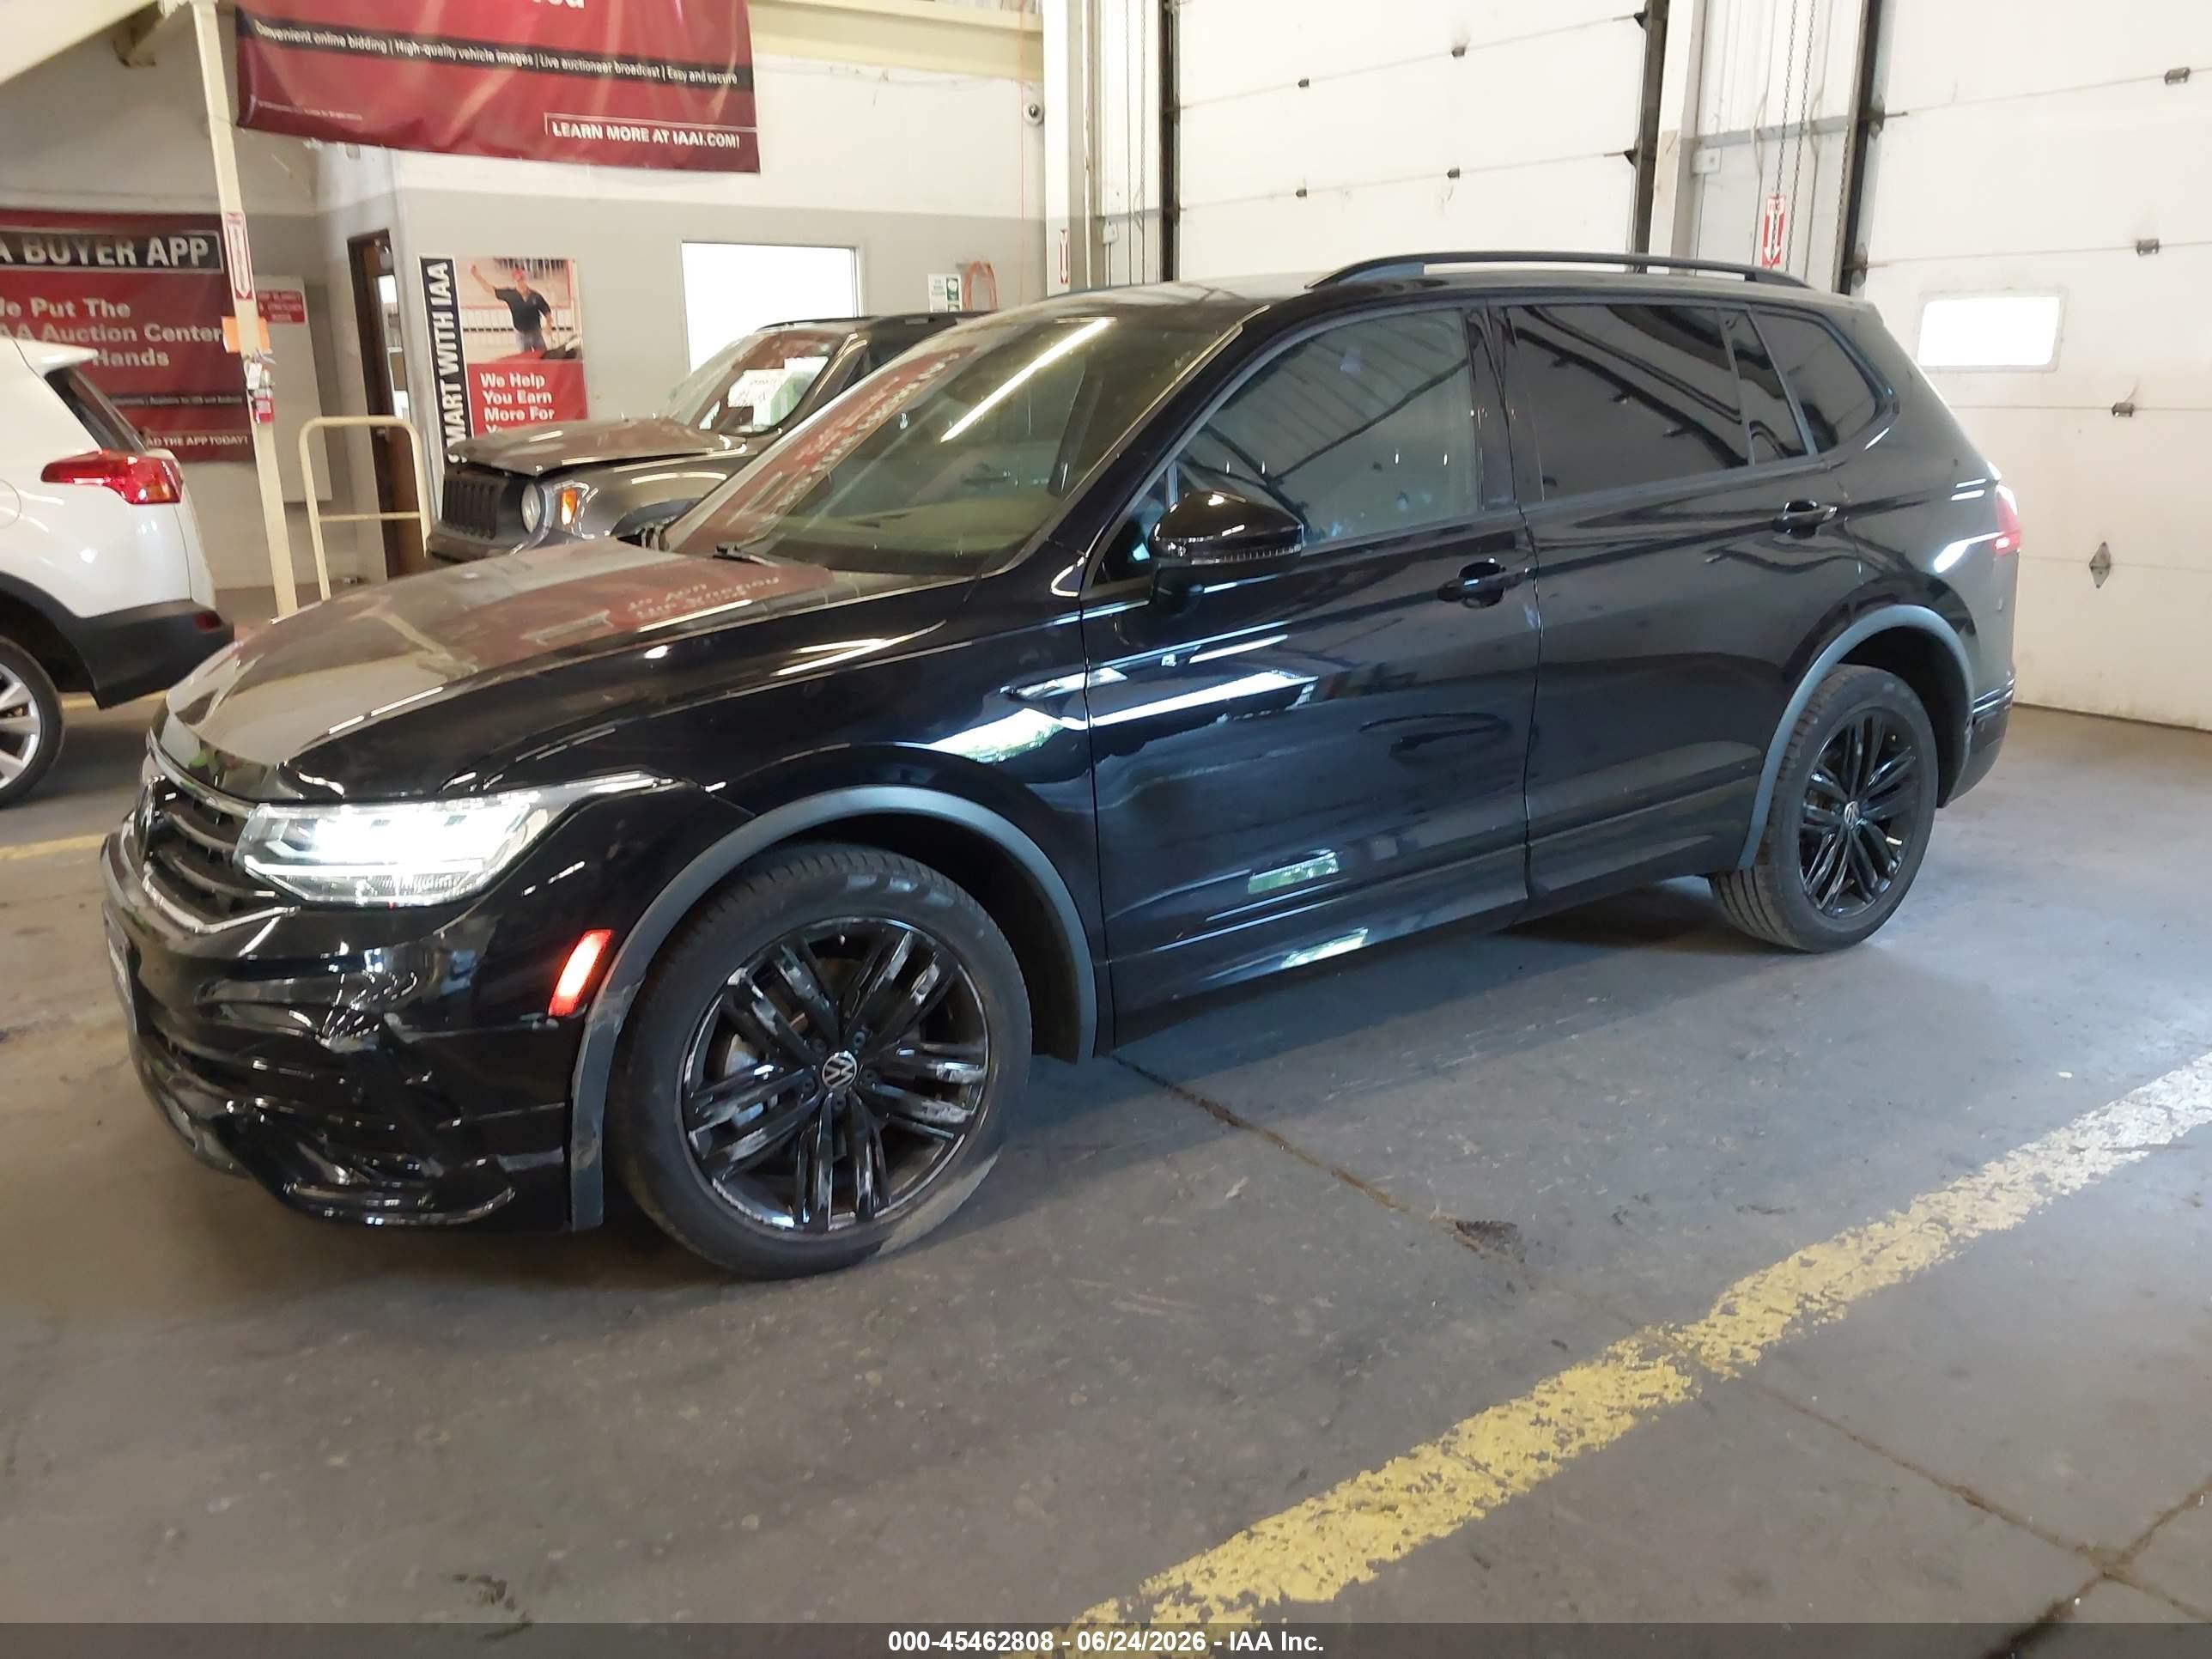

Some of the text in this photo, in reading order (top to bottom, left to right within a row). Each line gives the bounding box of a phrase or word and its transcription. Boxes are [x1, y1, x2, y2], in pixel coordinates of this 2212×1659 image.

[312, 30, 346, 48] online
[346, 33, 387, 55] bidding
[395, 38, 457, 61] High-quality
[457, 46, 495, 63] vehicle
[495, 48, 533, 67] images
[539, 53, 560, 69] Live
[561, 58, 612, 74] auctioneer
[614, 60, 660, 78] broadcast
[689, 69, 707, 82] and
[552, 121, 741, 149] LEARN MORE AT IAAI.COM!
[22, 234, 137, 267] BUYER
[147, 236, 209, 267] APP
[427, 262, 453, 307] IAA
[30, 297, 76, 318] Put
[82, 298, 131, 318] The
[39, 323, 137, 343] Auction
[432, 311, 459, 377] WITH
[92, 347, 170, 367] Hands
[480, 373, 546, 389] We Help
[482, 391, 552, 404] You Earn
[484, 406, 556, 422] More For
[163, 436, 185, 447] THE
[186, 436, 208, 447] APP
[209, 435, 249, 447] TODAY!
